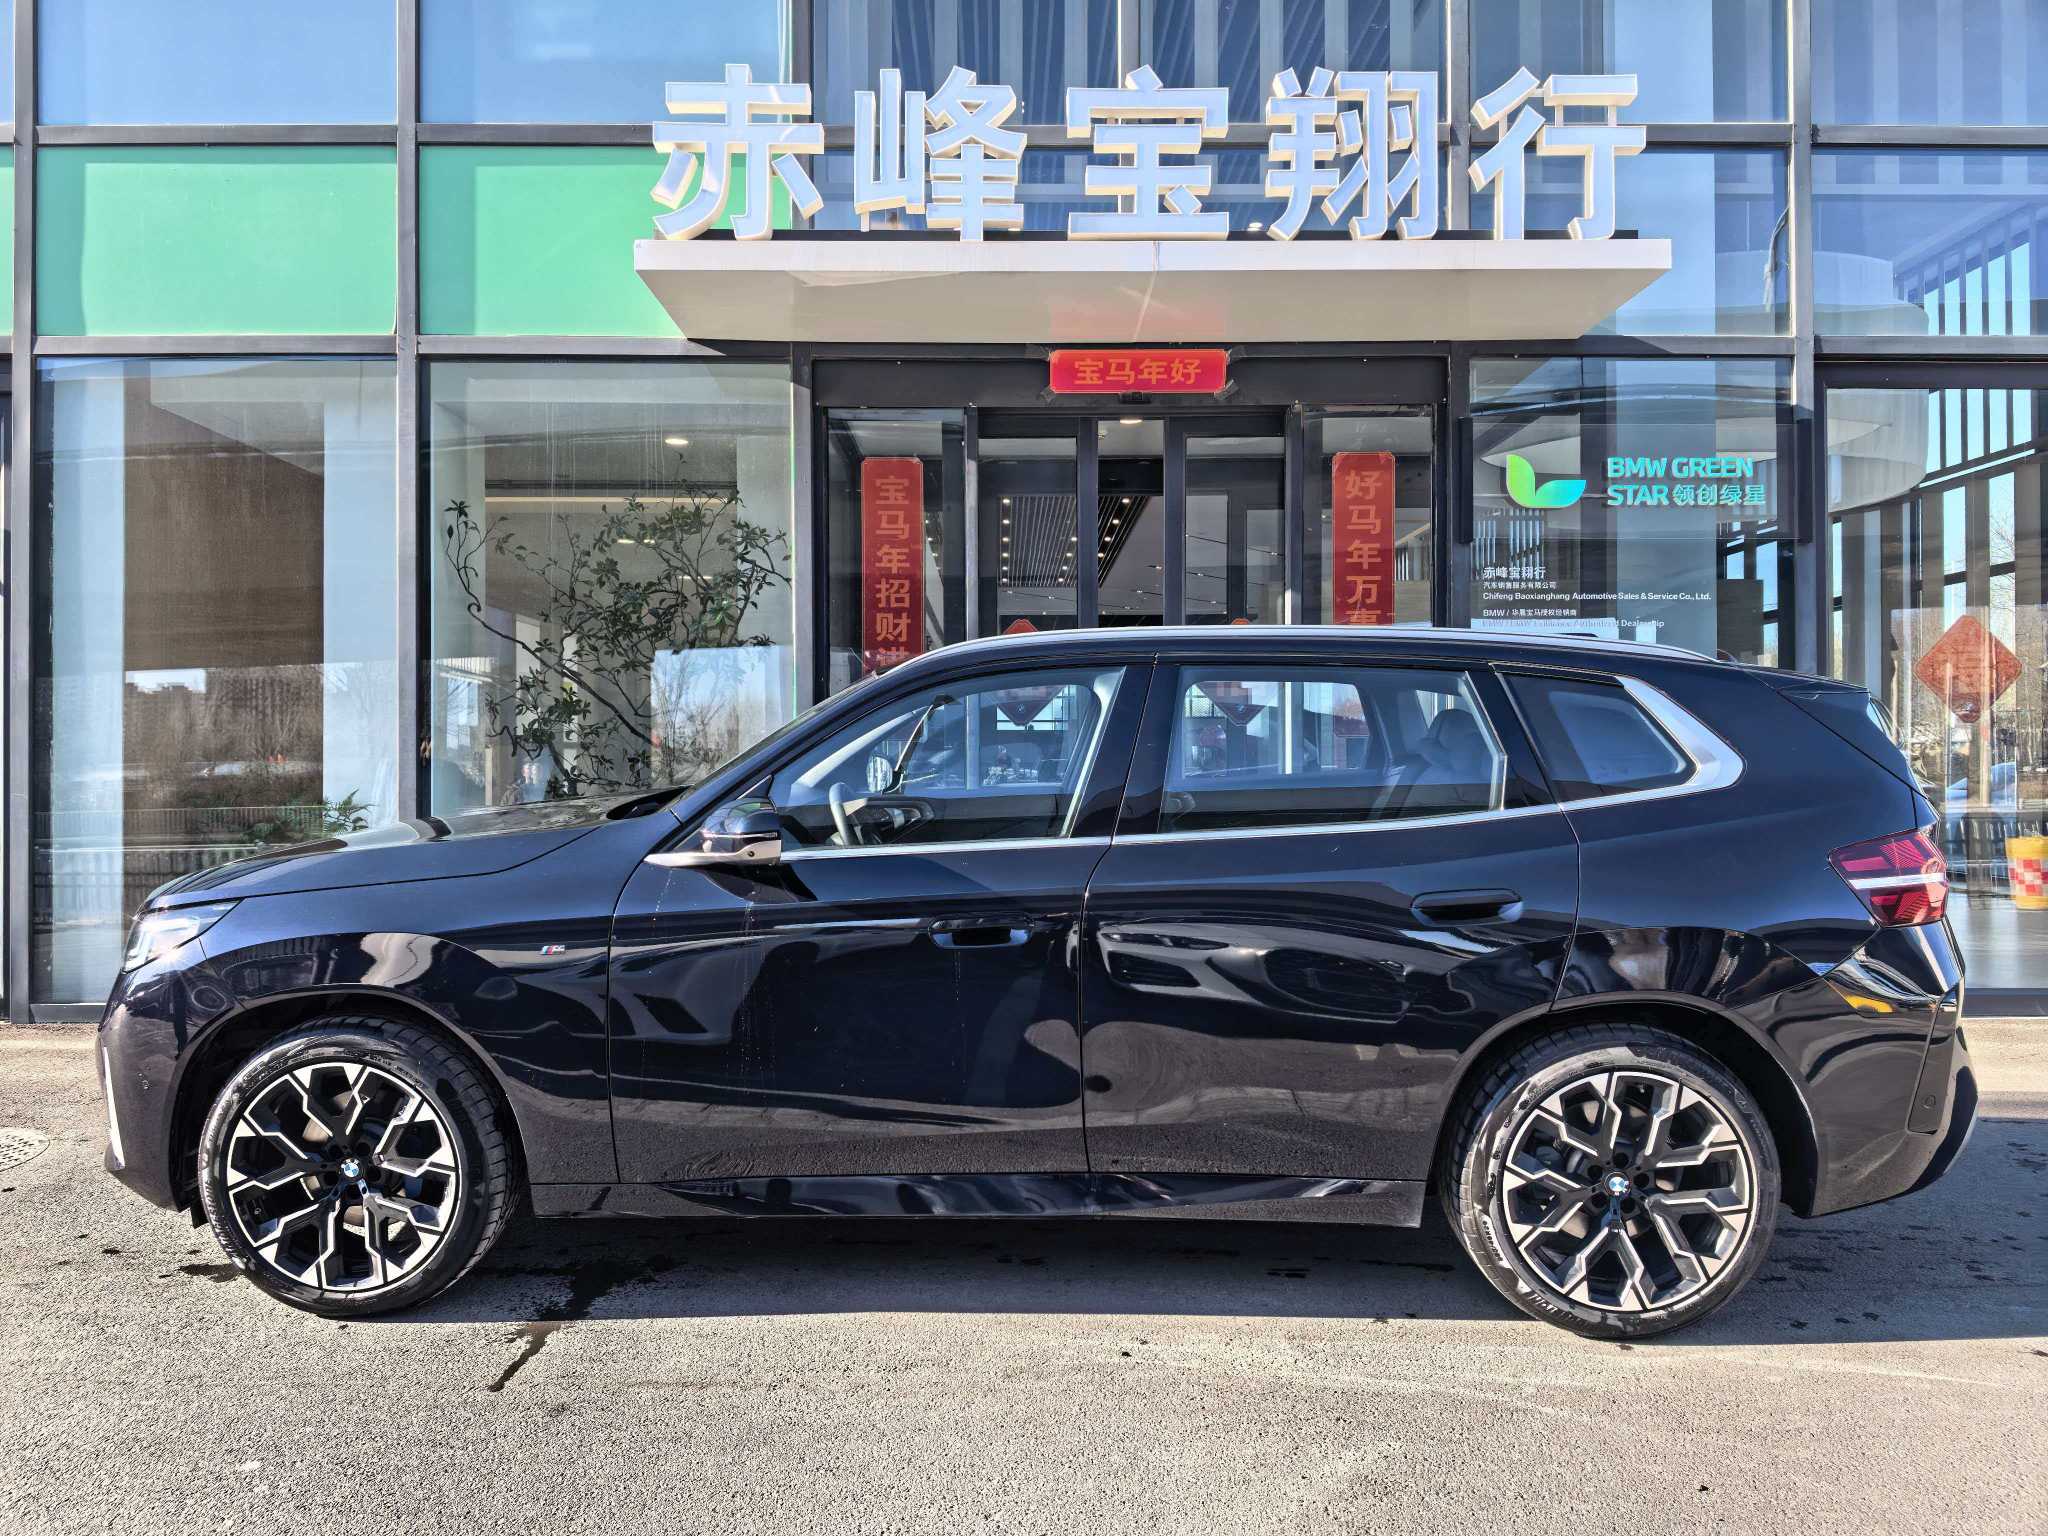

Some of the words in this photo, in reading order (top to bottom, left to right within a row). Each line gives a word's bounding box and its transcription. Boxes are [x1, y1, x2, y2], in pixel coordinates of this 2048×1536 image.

[650, 63, 1647, 241] 赤峰宝翔行
[1074, 357, 1202, 385] 宝马年好
[1607, 457, 1668, 478] BMW
[1671, 456, 1754, 479] GREEN
[1607, 484, 1669, 506] STAR
[1672, 484, 1767, 506] 领创绿星
[1483, 566, 1546, 580] 赤峰宝翔行
[1482, 592, 1513, 602] Chifeng
[1515, 592, 1570, 602] Baoxianghang
[1572, 592, 1617, 601] Automotive
[1618, 592, 1639, 601] Sales
[1640, 592, 1647, 601] &
[1647, 592, 1678, 601] Service
[1695, 592, 1712, 601] Ltd.
[1483, 609, 1505, 617] BMW
